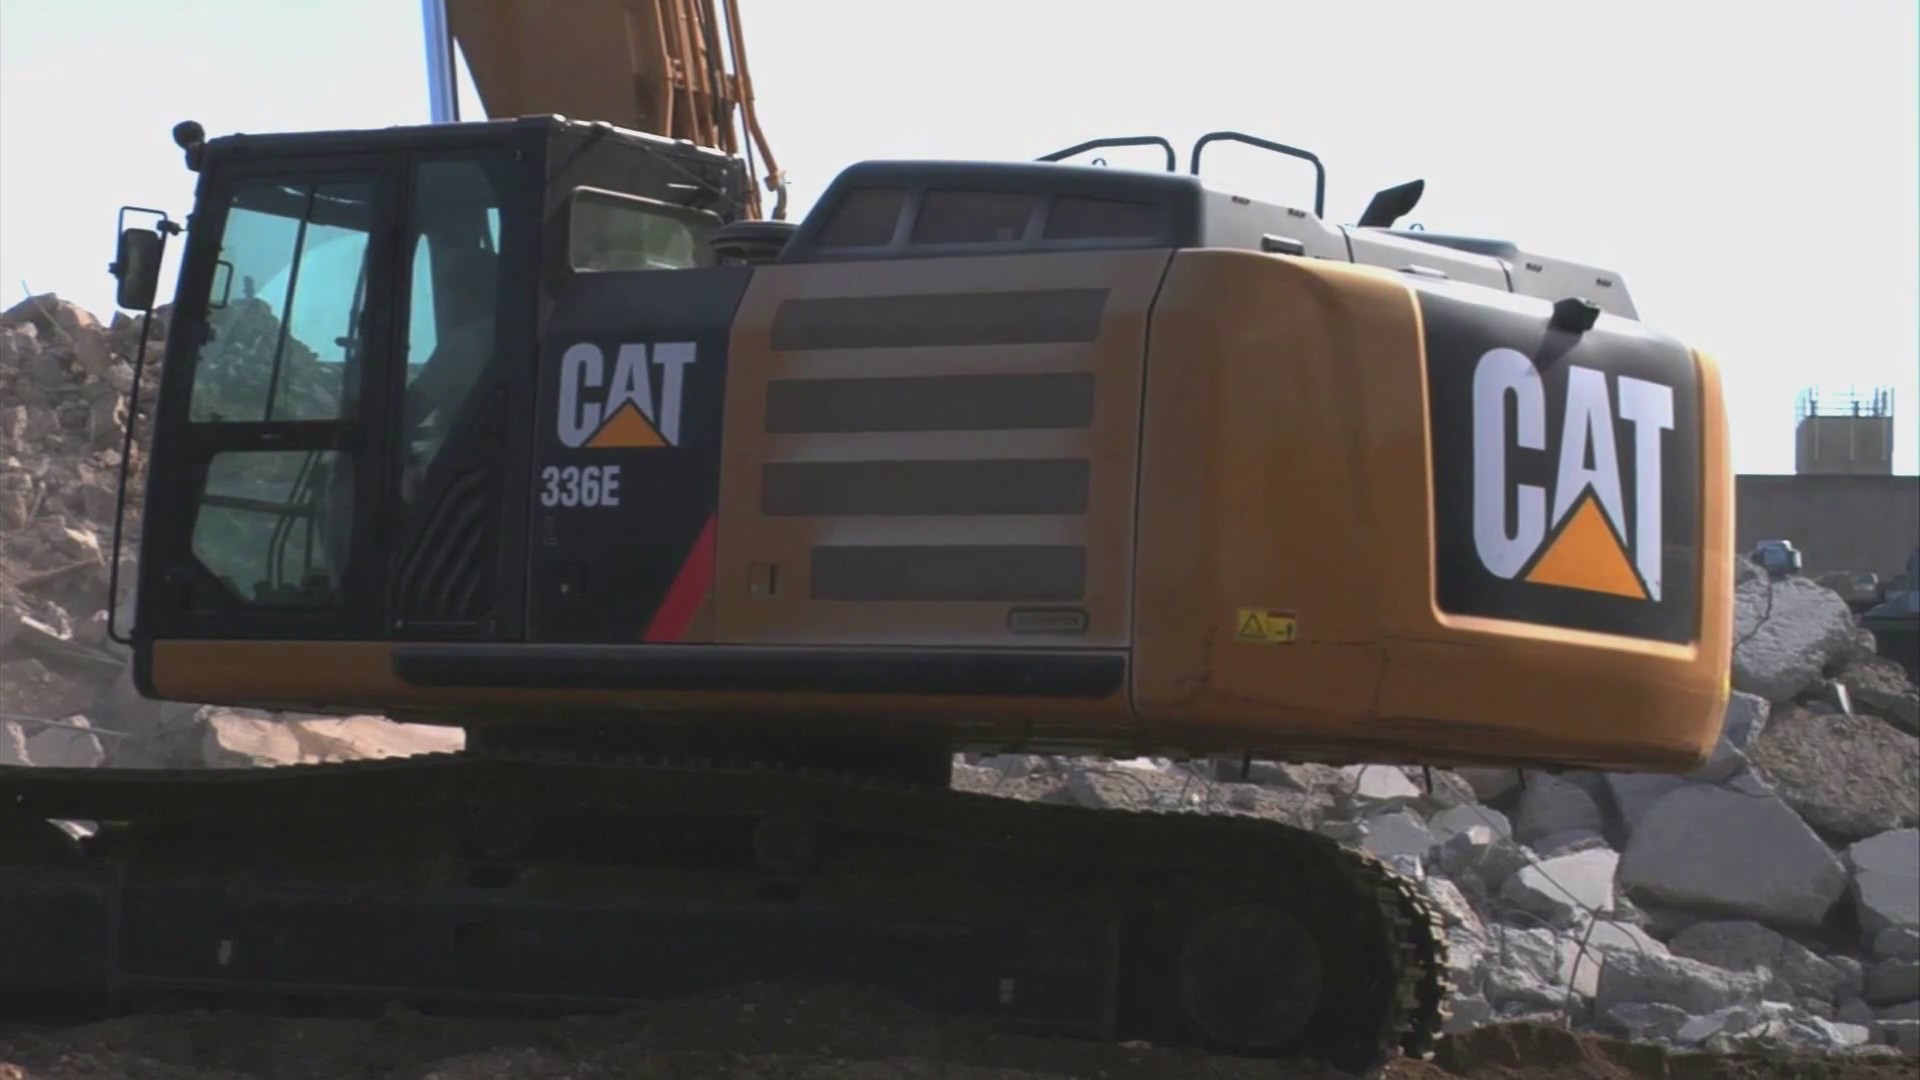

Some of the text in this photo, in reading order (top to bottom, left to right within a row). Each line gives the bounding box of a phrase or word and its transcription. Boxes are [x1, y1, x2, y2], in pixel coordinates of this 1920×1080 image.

[557, 342, 696, 448] CAT
[541, 465, 620, 507] 336E
[1473, 347, 1674, 602] CAT
